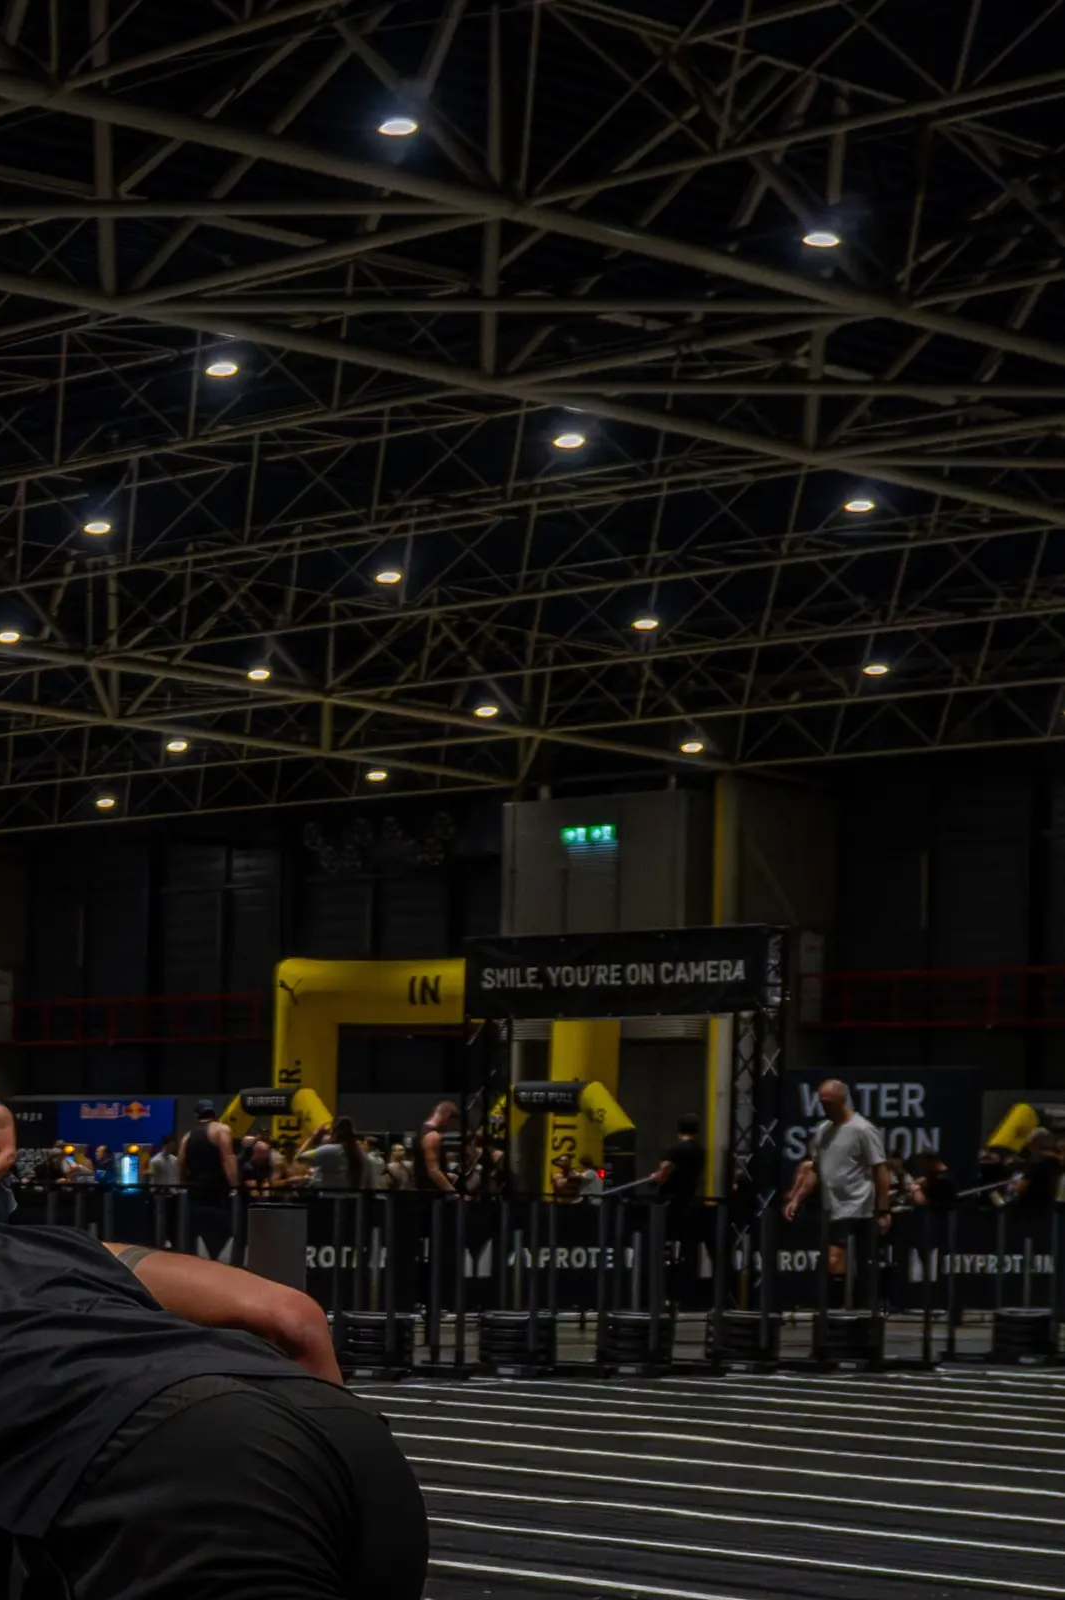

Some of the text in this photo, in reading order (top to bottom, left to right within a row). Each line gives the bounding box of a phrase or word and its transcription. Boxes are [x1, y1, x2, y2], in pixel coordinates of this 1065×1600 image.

[407, 974, 440, 1005] IN
[480, 958, 747, 991] SMILE, YOU'RE ON CAMERA
[799, 1082, 926, 1118] WTER
